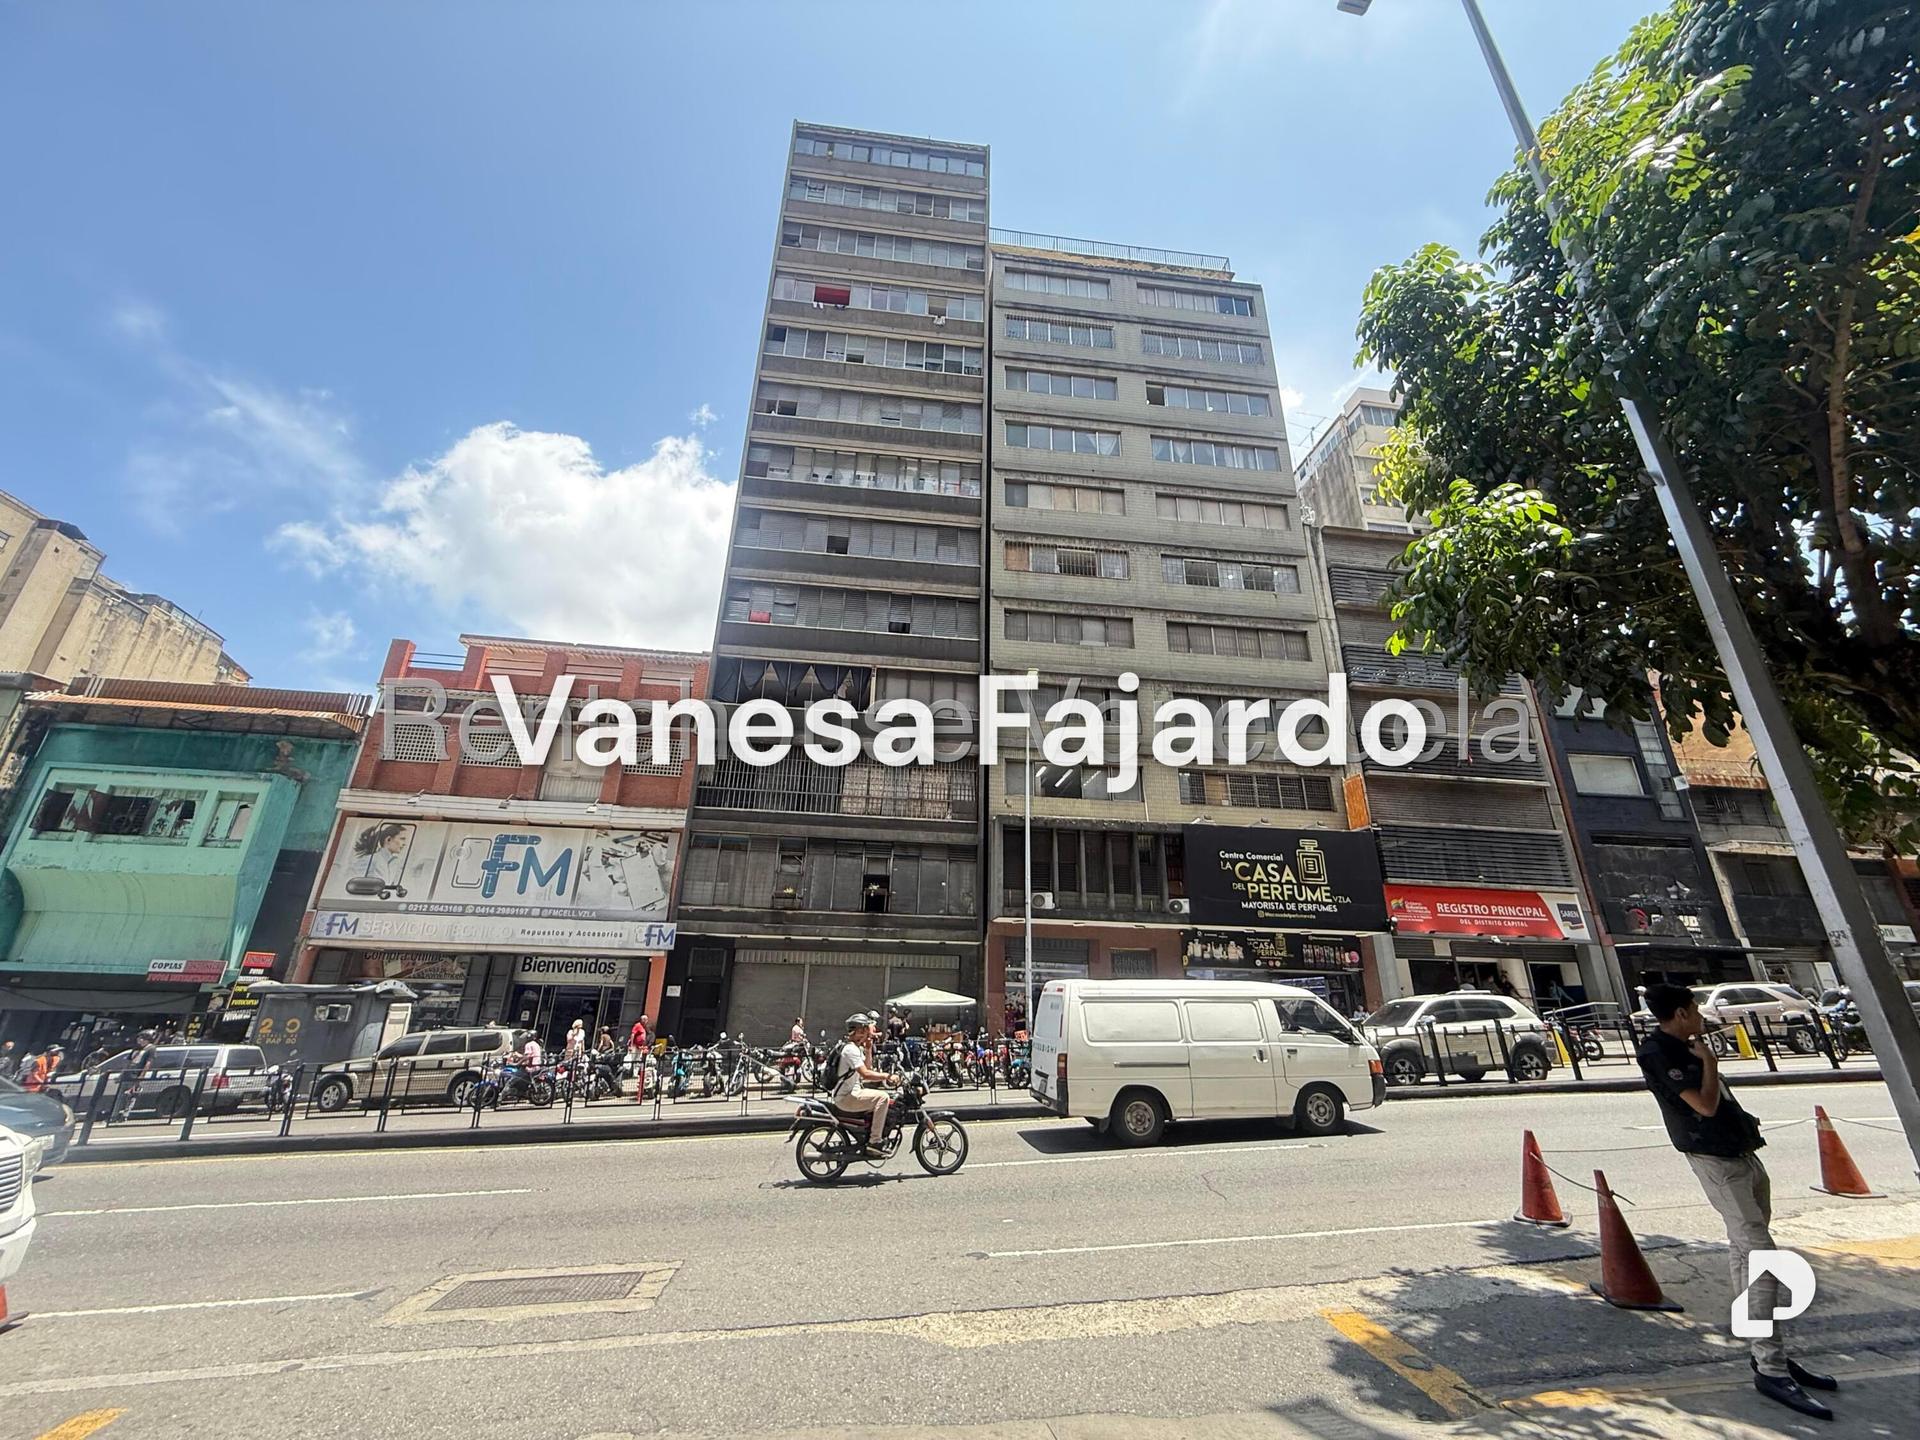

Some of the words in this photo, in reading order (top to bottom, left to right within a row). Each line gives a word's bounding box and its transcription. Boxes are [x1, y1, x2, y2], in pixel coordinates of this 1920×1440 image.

[1219, 850, 1244, 859] Centro
[1246, 852, 1284, 862] Comercial
[1220, 861, 1233, 871] LA
[1234, 861, 1297, 884] CASA
[1232, 882, 1246, 891] DEL
[1247, 882, 1333, 903] PERFUME
[1241, 901, 1285, 911] MAYORISTA
[1286, 902, 1297, 911] DE
[1298, 903, 1338, 913] PERFUMES
[1436, 902, 1489, 915] REGISTRO
[1491, 905, 1546, 918] PRINCIPAL
[1460, 918, 1472, 926] DEL
[1474, 919, 1502, 927] DISTRITO
[1503, 920, 1528, 928] CAPITAL
[520, 928, 565, 938] Repuestos
[576, 929, 624, 939] Accesorios
[151, 962, 183, 970] COPIAS
[521, 956, 616, 975] Bienvenidos
